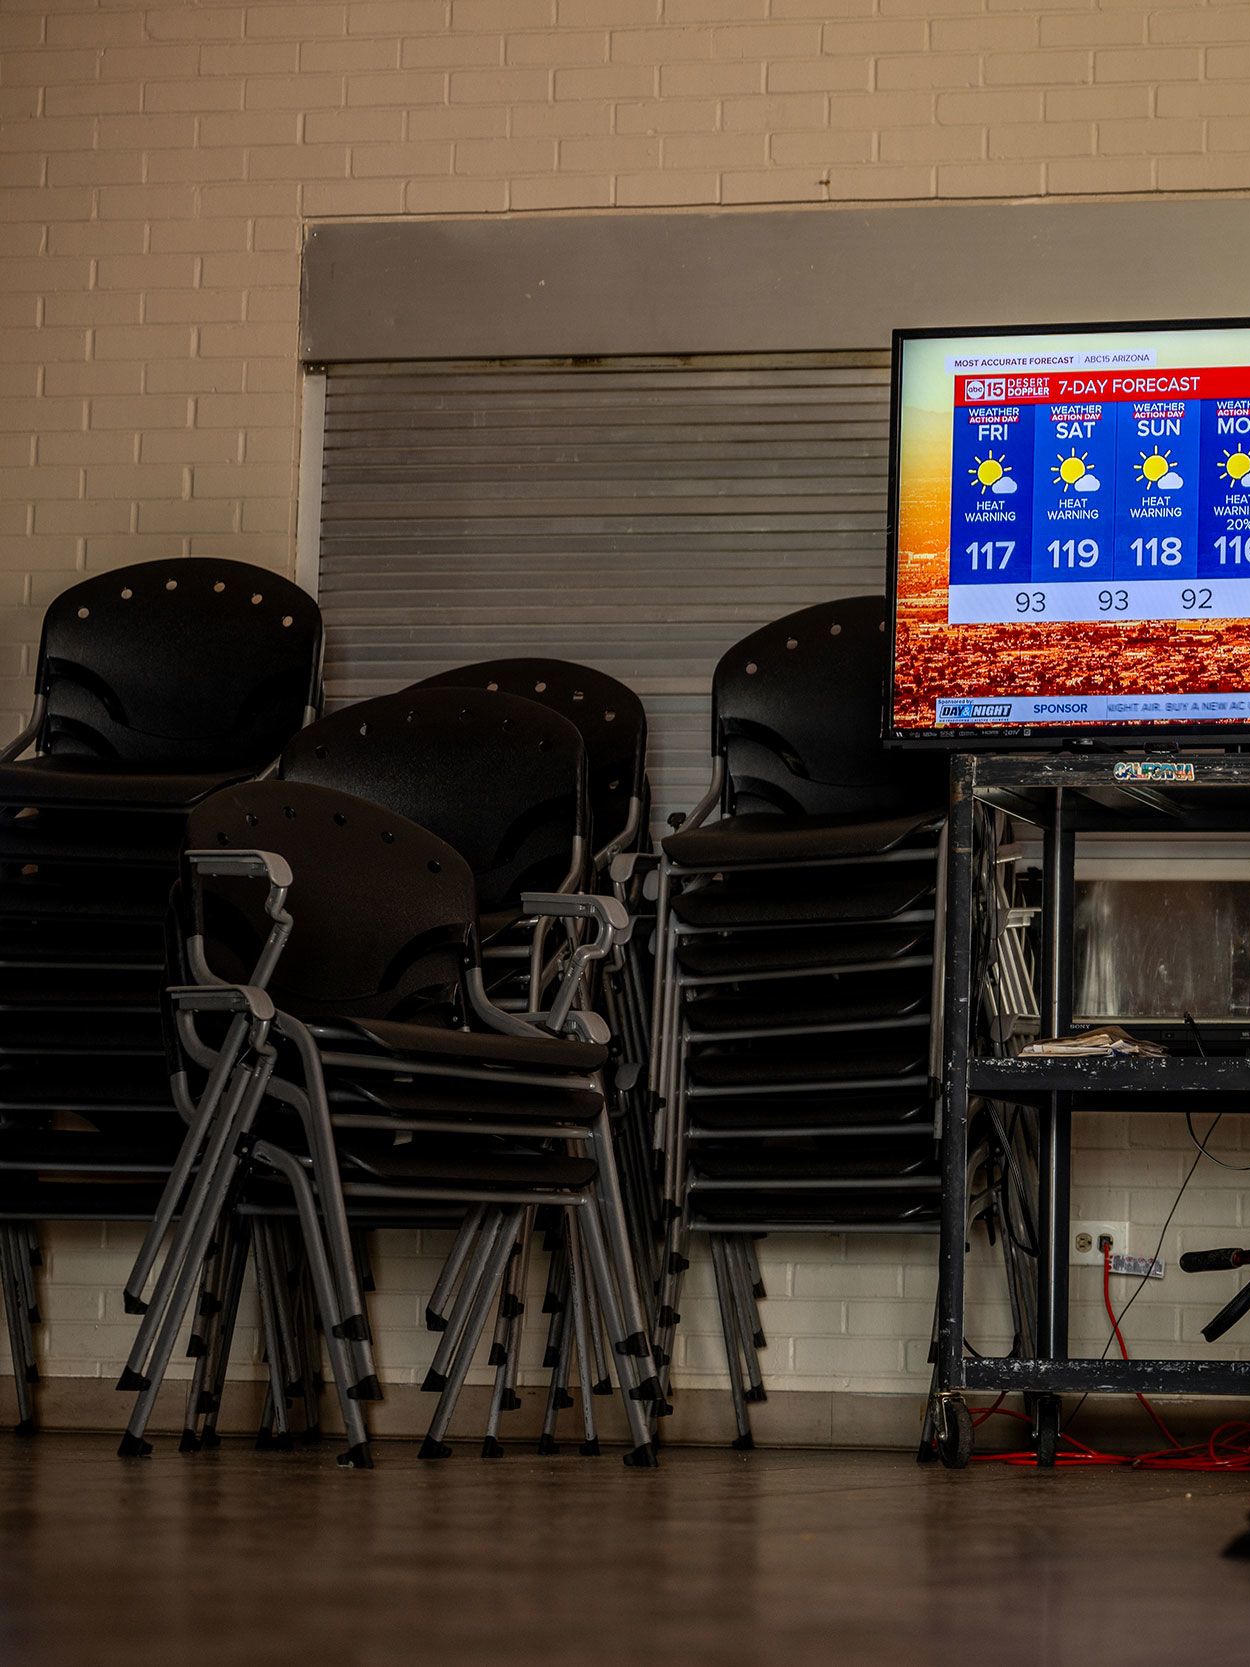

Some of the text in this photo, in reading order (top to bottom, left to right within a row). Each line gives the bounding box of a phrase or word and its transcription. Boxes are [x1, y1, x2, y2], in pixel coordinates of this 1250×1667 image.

[955, 356, 1074, 367] MOST ACCURATE FORECAST
[1084, 355, 1110, 363] ABC15
[1007, 378, 1049, 387] DESERT
[1059, 377, 1200, 394] 7-DAY FORECAST
[968, 382, 1003, 396] abc 15
[1007, 387, 1049, 396] DOPPLER
[969, 407, 1019, 416] WEATHER
[1051, 405, 1102, 414] WEATHER
[1134, 402, 1185, 411] WEATHER
[978, 424, 1008, 441] FRI
[1056, 422, 1095, 439] SAT
[1138, 419, 1180, 436] SUN
[977, 501, 1005, 510] HEAT
[1059, 499, 1088, 508] HEAT
[1142, 497, 1171, 506] HEAT
[965, 512, 1016, 522] WARNING
[1048, 510, 1099, 519] WARNING
[1130, 508, 1182, 517] WARNING
[965, 541, 1015, 570] 117
[1047, 539, 1099, 568] 119
[1130, 537, 1182, 566] 118
[1015, 592, 1046, 612] 93
[1098, 590, 1128, 610] 93
[1181, 588, 1212, 609] 92
[1033, 704, 1088, 713] SPONSOR
[1165, 703, 1187, 712] BUY
[1191, 703, 1200, 711] A
[1202, 701, 1229, 711] NEW
[1230, 701, 1245, 710] AC
[1113, 762, 1195, 781] CALIFORNIA
